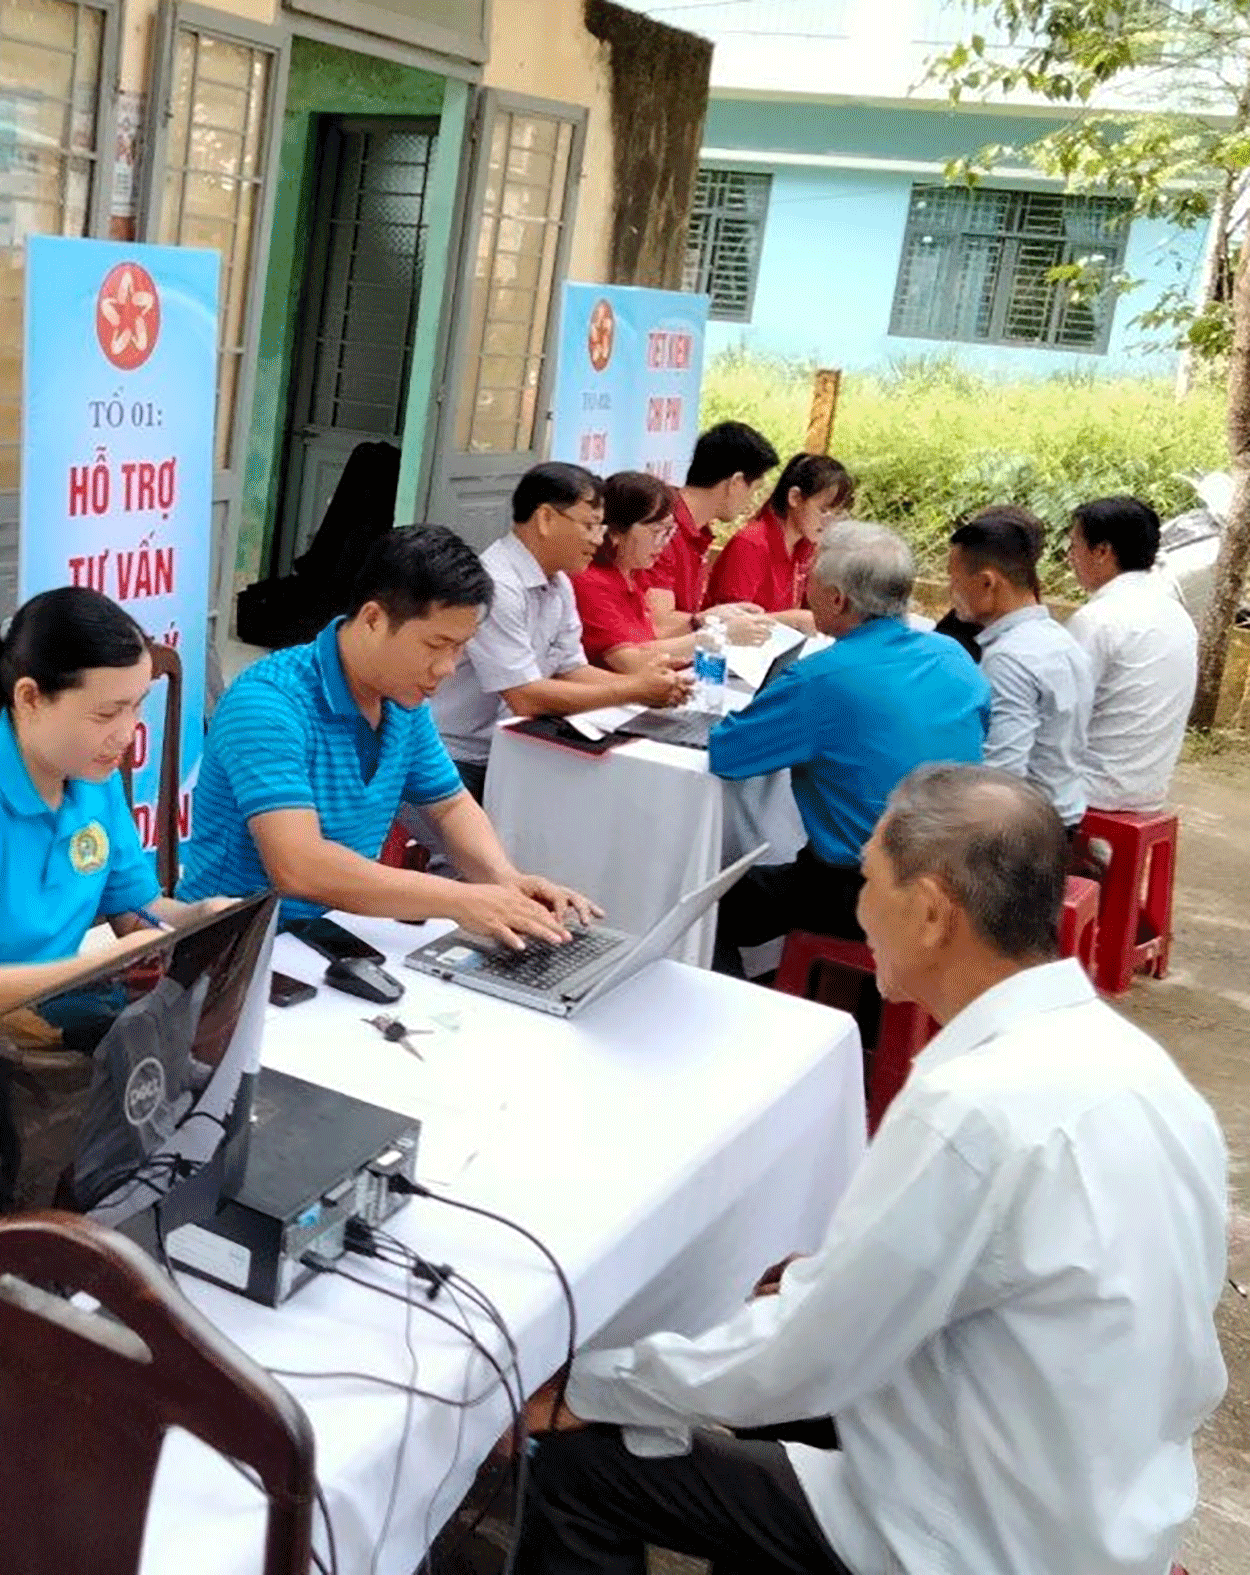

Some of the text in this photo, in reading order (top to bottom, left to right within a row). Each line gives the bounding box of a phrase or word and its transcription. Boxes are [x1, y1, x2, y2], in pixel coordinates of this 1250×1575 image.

[90, 386, 163, 428] TỔ 01:
[69, 445, 177, 520] HỖ TRỢ
[117, 530, 174, 601] VẤN
